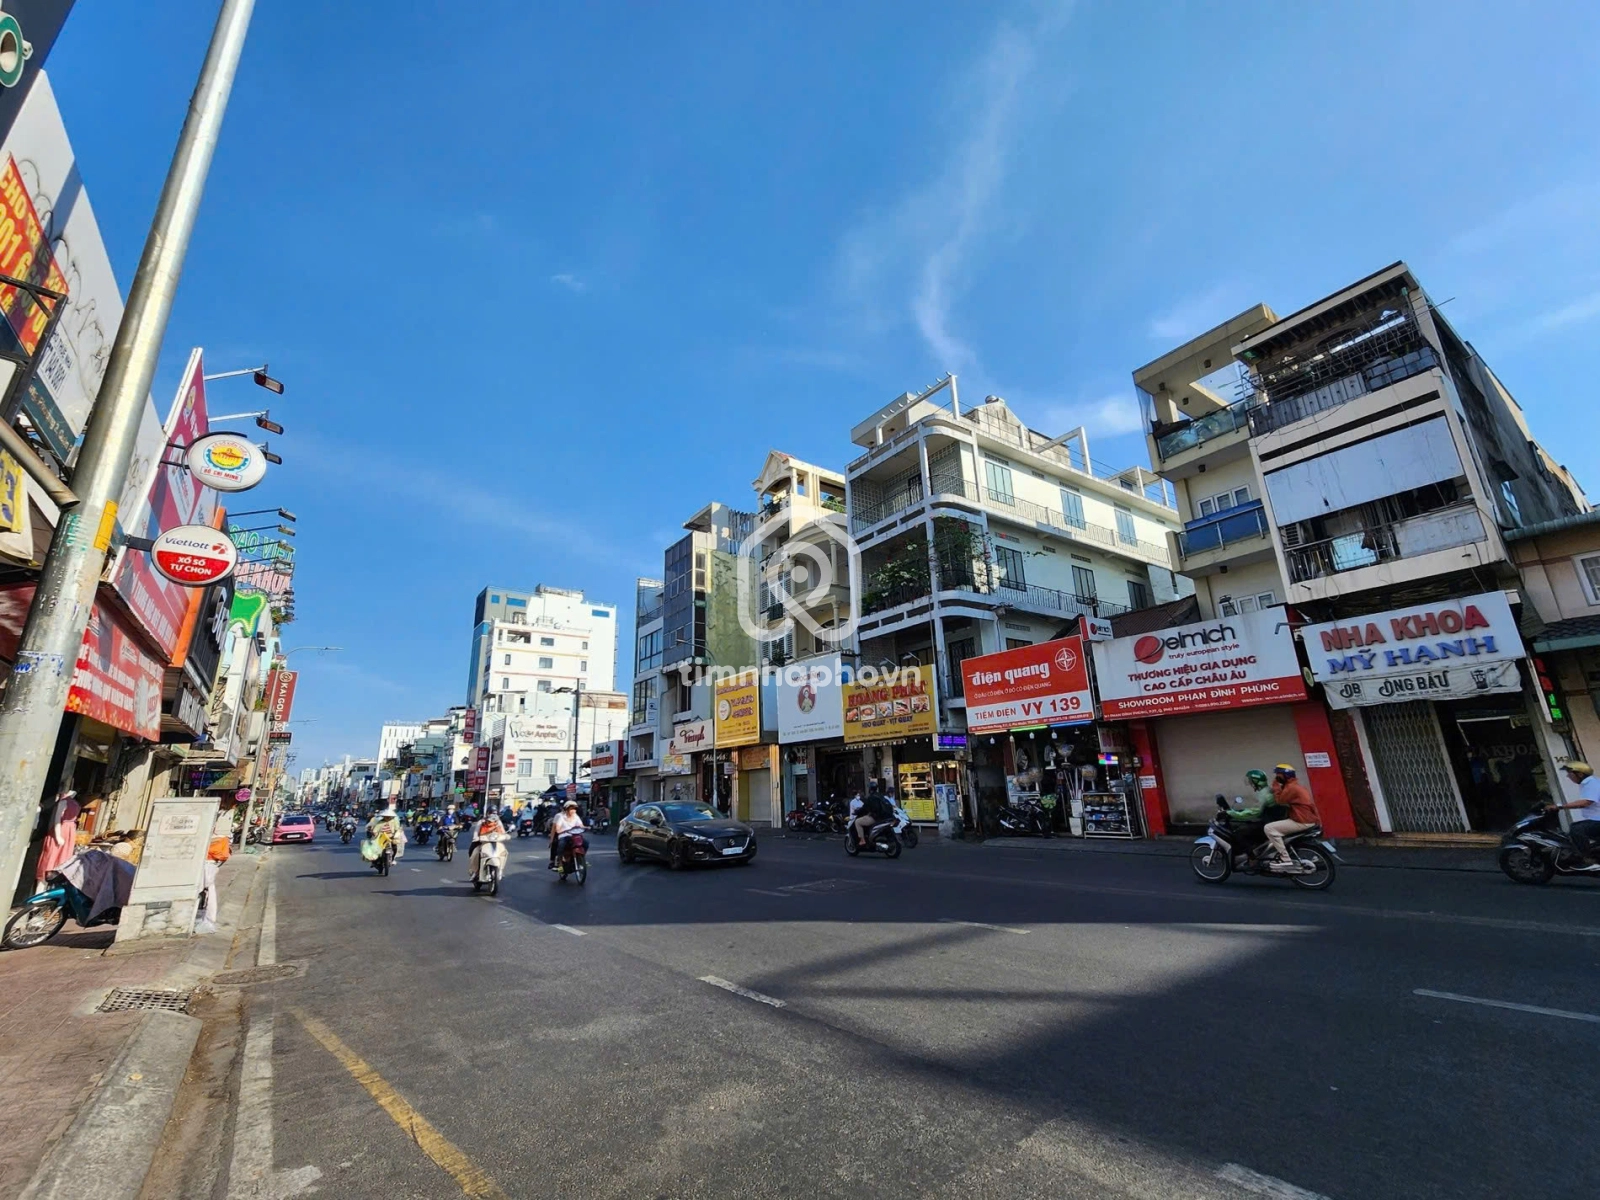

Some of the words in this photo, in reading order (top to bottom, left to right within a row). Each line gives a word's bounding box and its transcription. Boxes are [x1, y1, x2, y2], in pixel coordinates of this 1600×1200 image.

[165, 537, 209, 550] Vietlott
[170, 563, 183, 571] TỰ
[184, 564, 212, 576] CHỌN
[1165, 624, 1237, 651] elmich
[1320, 622, 1387, 652] NHA
[1390, 605, 1490, 641] KHOA
[1169, 652, 1185, 660] truly
[1186, 646, 1220, 658] european
[1222, 643, 1240, 652] style
[1327, 648, 1376, 675] MỸ
[1383, 635, 1499, 666] HẠNH
[967, 671, 1002, 686] điện
[1004, 662, 1050, 685] quang
[1128, 668, 1171, 682] THƯƠNG
[1173, 663, 1198, 676] HIỆU
[1200, 659, 1221, 671] GIA
[1222, 655, 1257, 668] DỤNG
[1143, 681, 1167, 692] CAO
[1169, 674, 1193, 689] CẤP
[1195, 673, 1228, 685] CHÂU
[1230, 669, 1247, 680] ÂU
[1118, 696, 1175, 709] SHOWROOM
[1178, 692, 1207, 702] PHAN
[1210, 686, 1236, 698] ĐÌNH
[1240, 682, 1280, 695] PHÙNG
[274, 698, 285, 721] GOLD
[975, 709, 995, 721] TIỆM
[996, 707, 1017, 719] ĐIỆN
[1021, 701, 1044, 716] VY
[1049, 696, 1081, 713] 139
